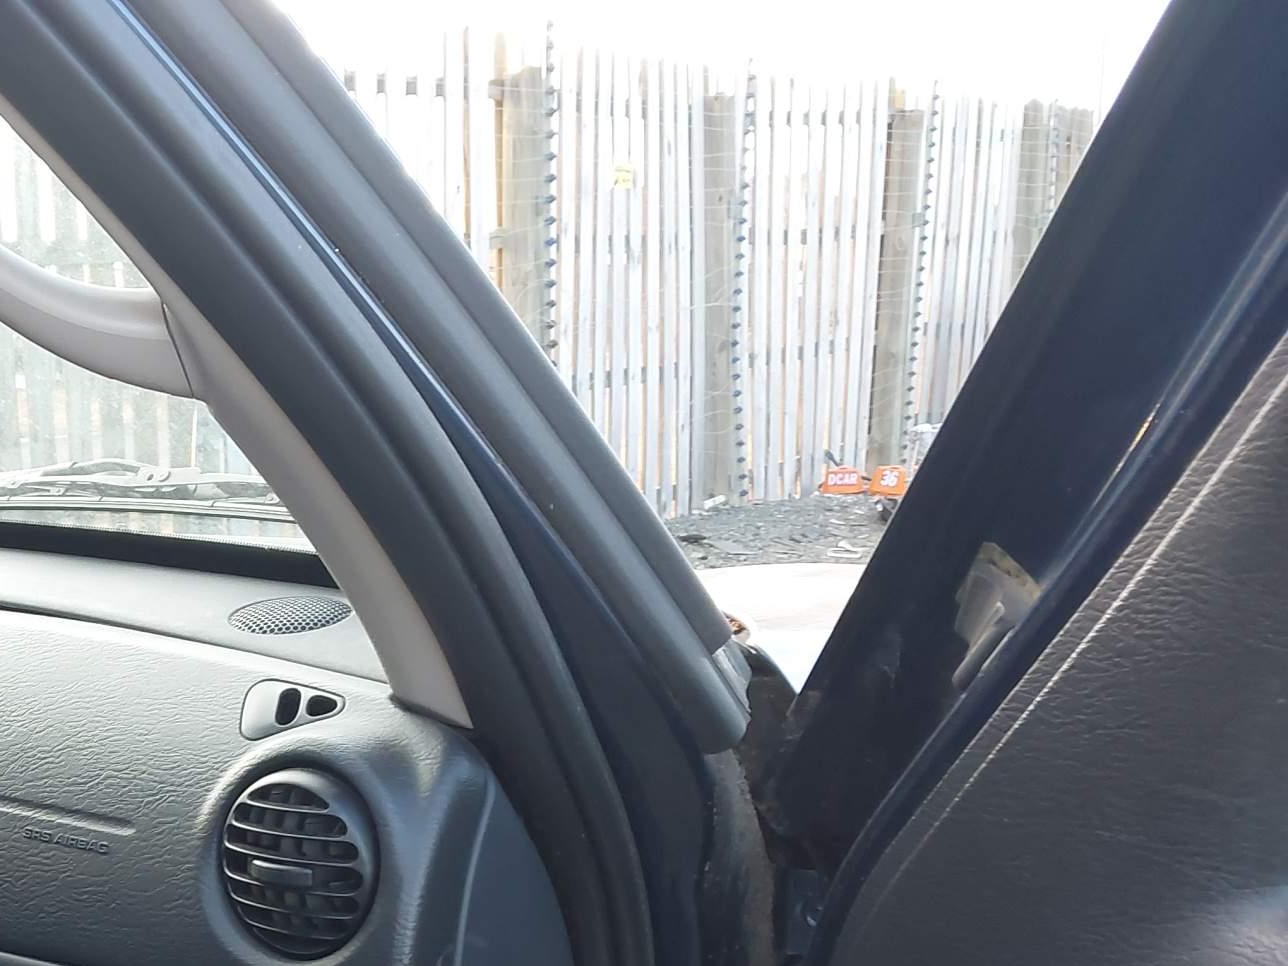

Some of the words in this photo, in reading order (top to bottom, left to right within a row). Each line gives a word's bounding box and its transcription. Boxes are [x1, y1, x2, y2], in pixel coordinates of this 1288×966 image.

[880, 470, 900, 487] 36
[22, 826, 52, 843] SRS
[53, 833, 110, 854] AIRBAG
